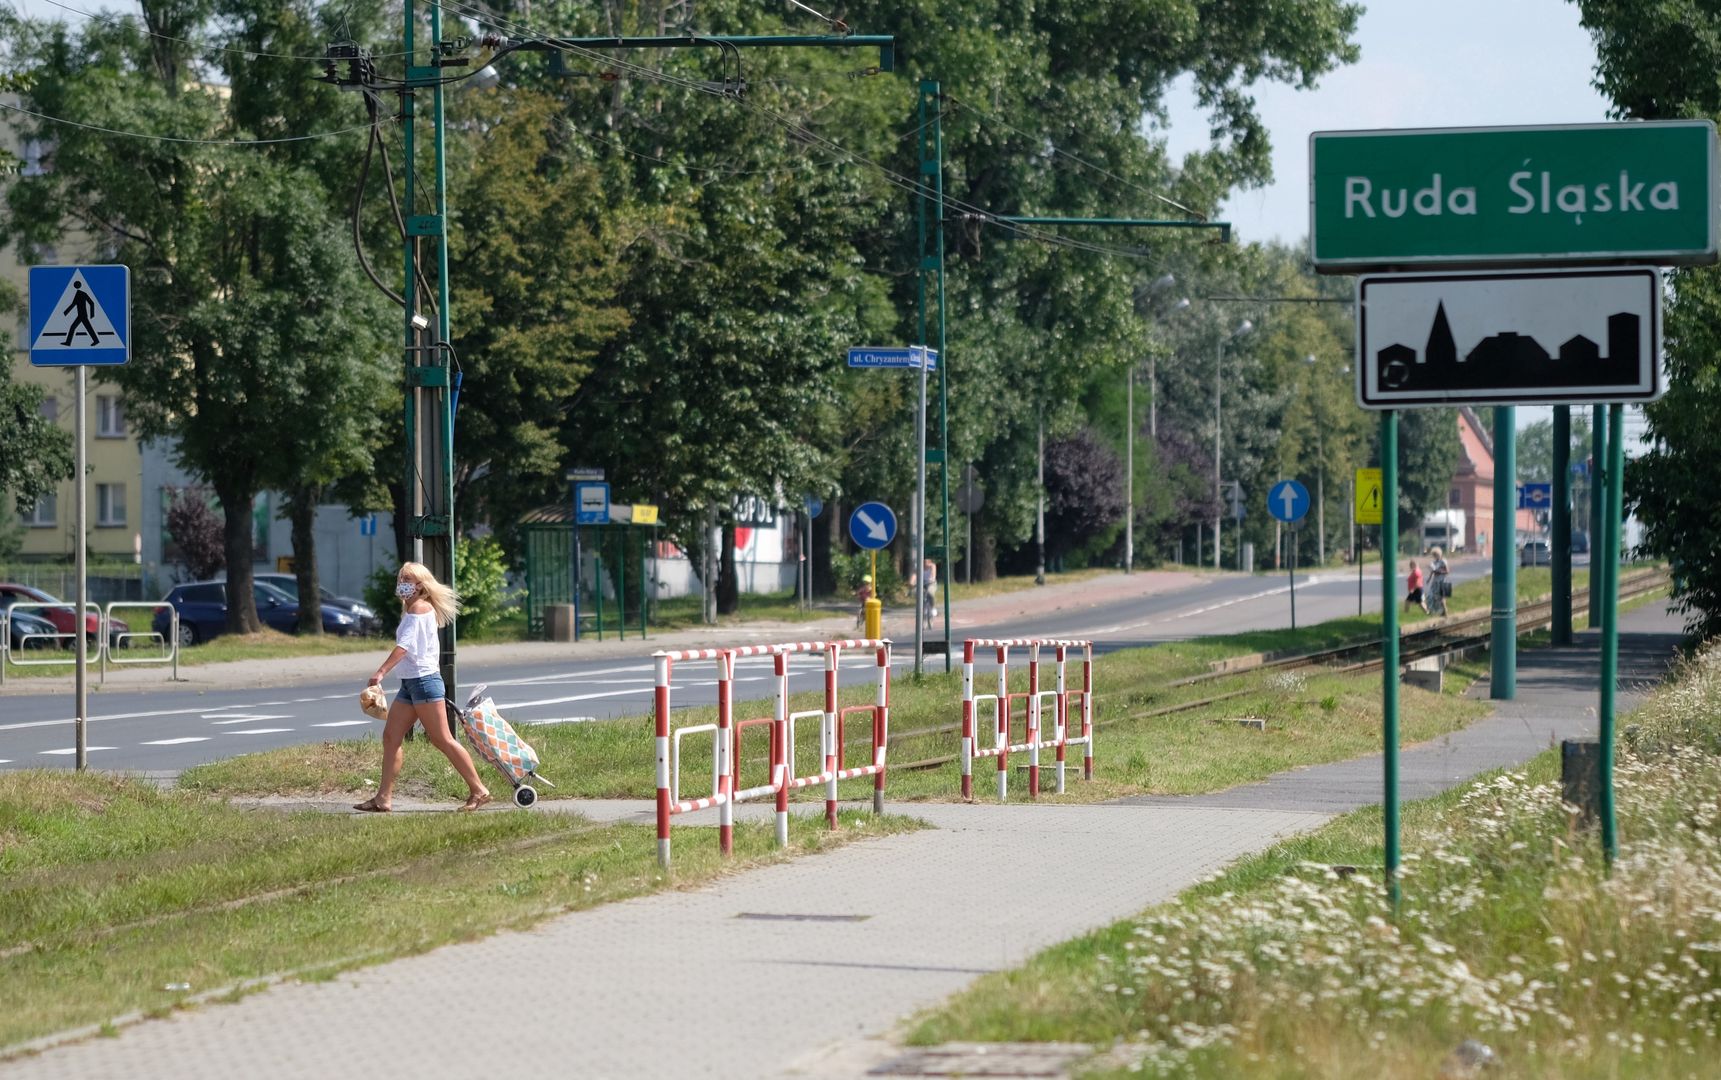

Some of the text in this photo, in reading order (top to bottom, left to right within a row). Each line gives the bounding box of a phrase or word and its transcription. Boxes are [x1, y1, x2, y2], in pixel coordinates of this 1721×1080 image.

[1345, 158, 1679, 225] Ruda Śląska
[853, 354, 863, 363] ul.
